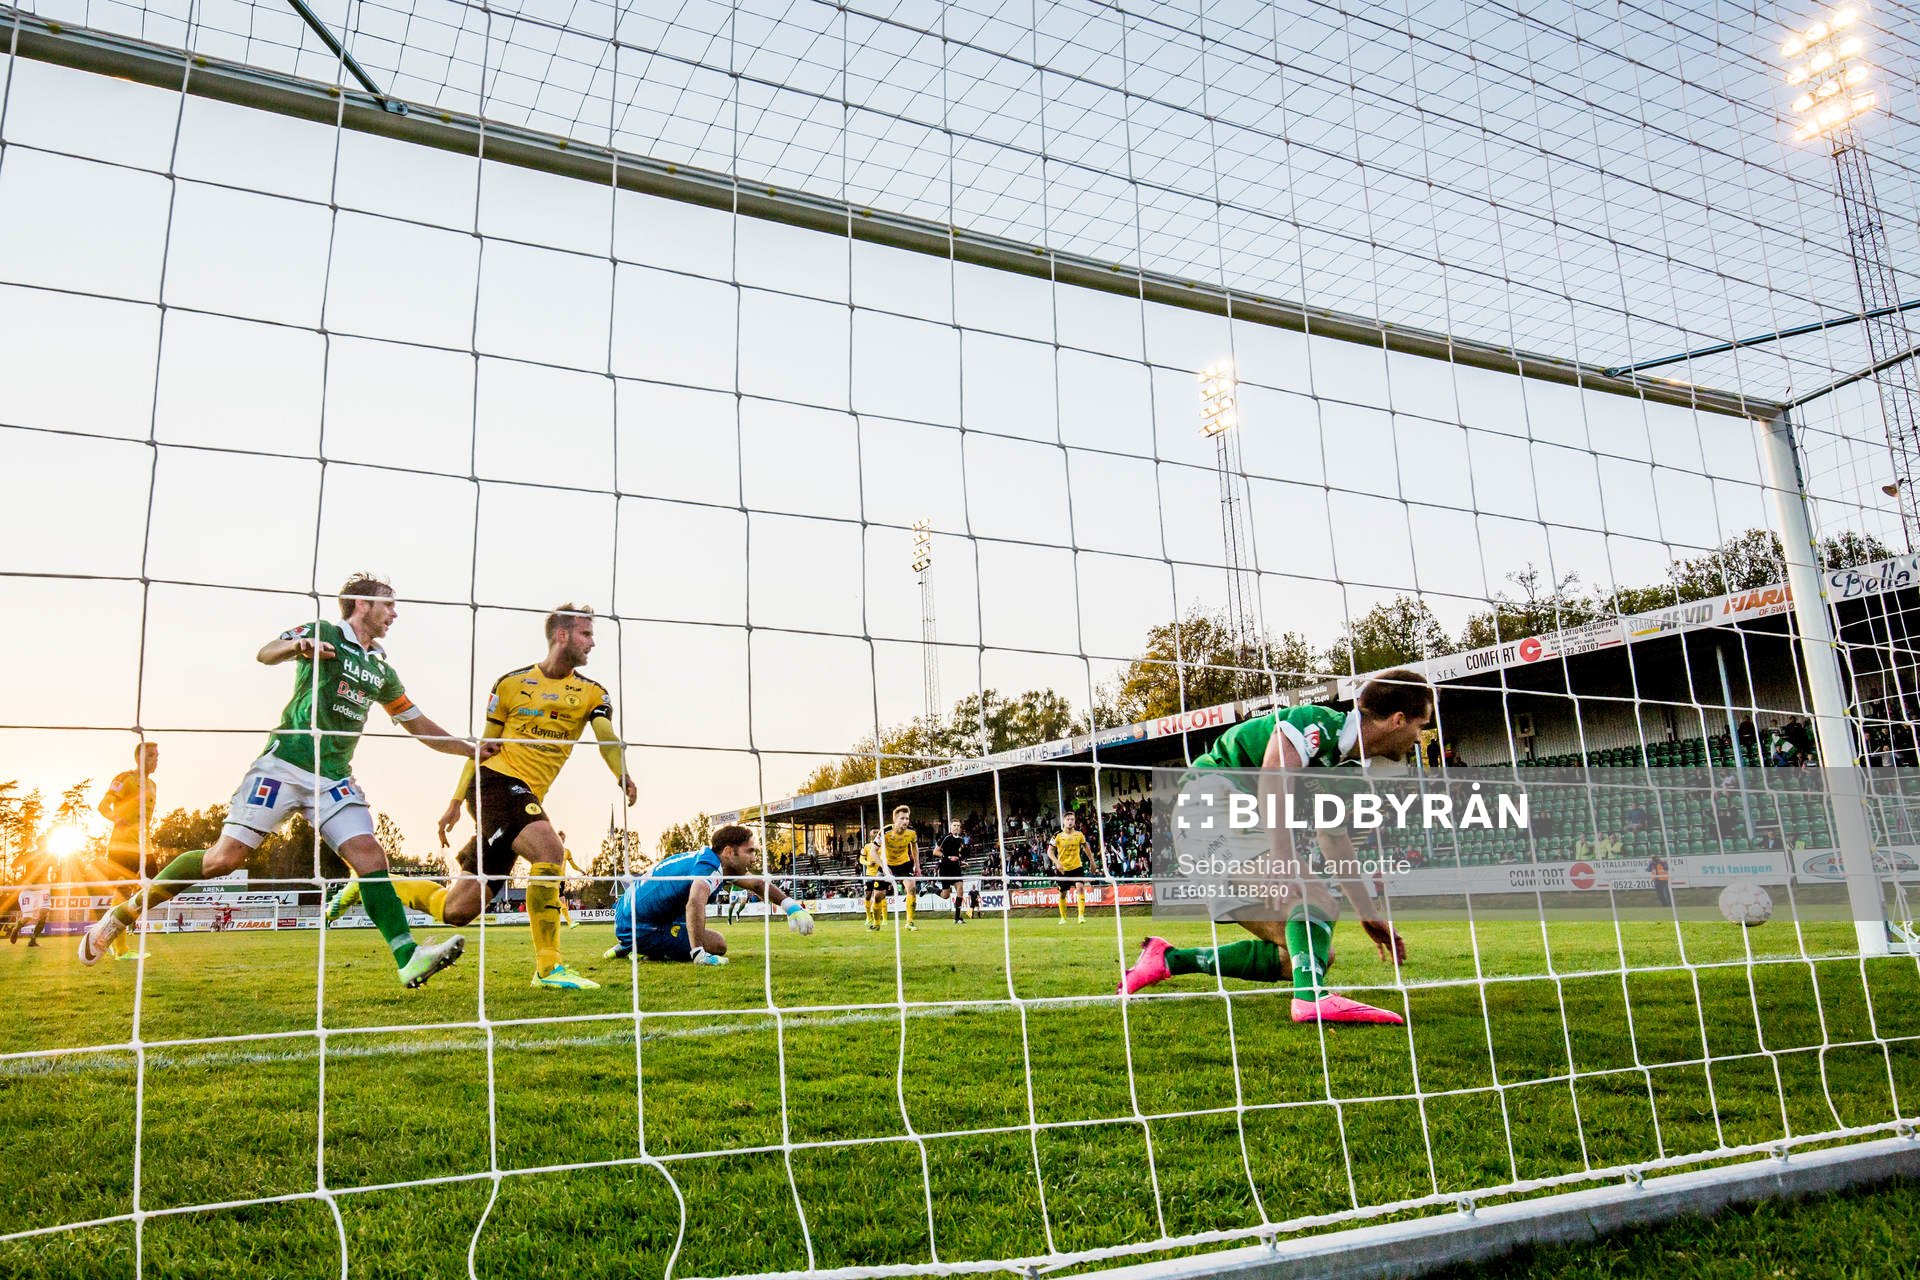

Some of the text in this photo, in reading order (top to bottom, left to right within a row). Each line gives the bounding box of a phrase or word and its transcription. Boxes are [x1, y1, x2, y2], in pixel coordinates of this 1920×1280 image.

[1831, 561, 1910, 598] Bella
[1540, 619, 1619, 641] INSTALATIONSGRUPPEN
[531, 725, 571, 740] daymark
[1156, 706, 1224, 737] RICOH
[1613, 880, 1656, 889] 0522-2010
